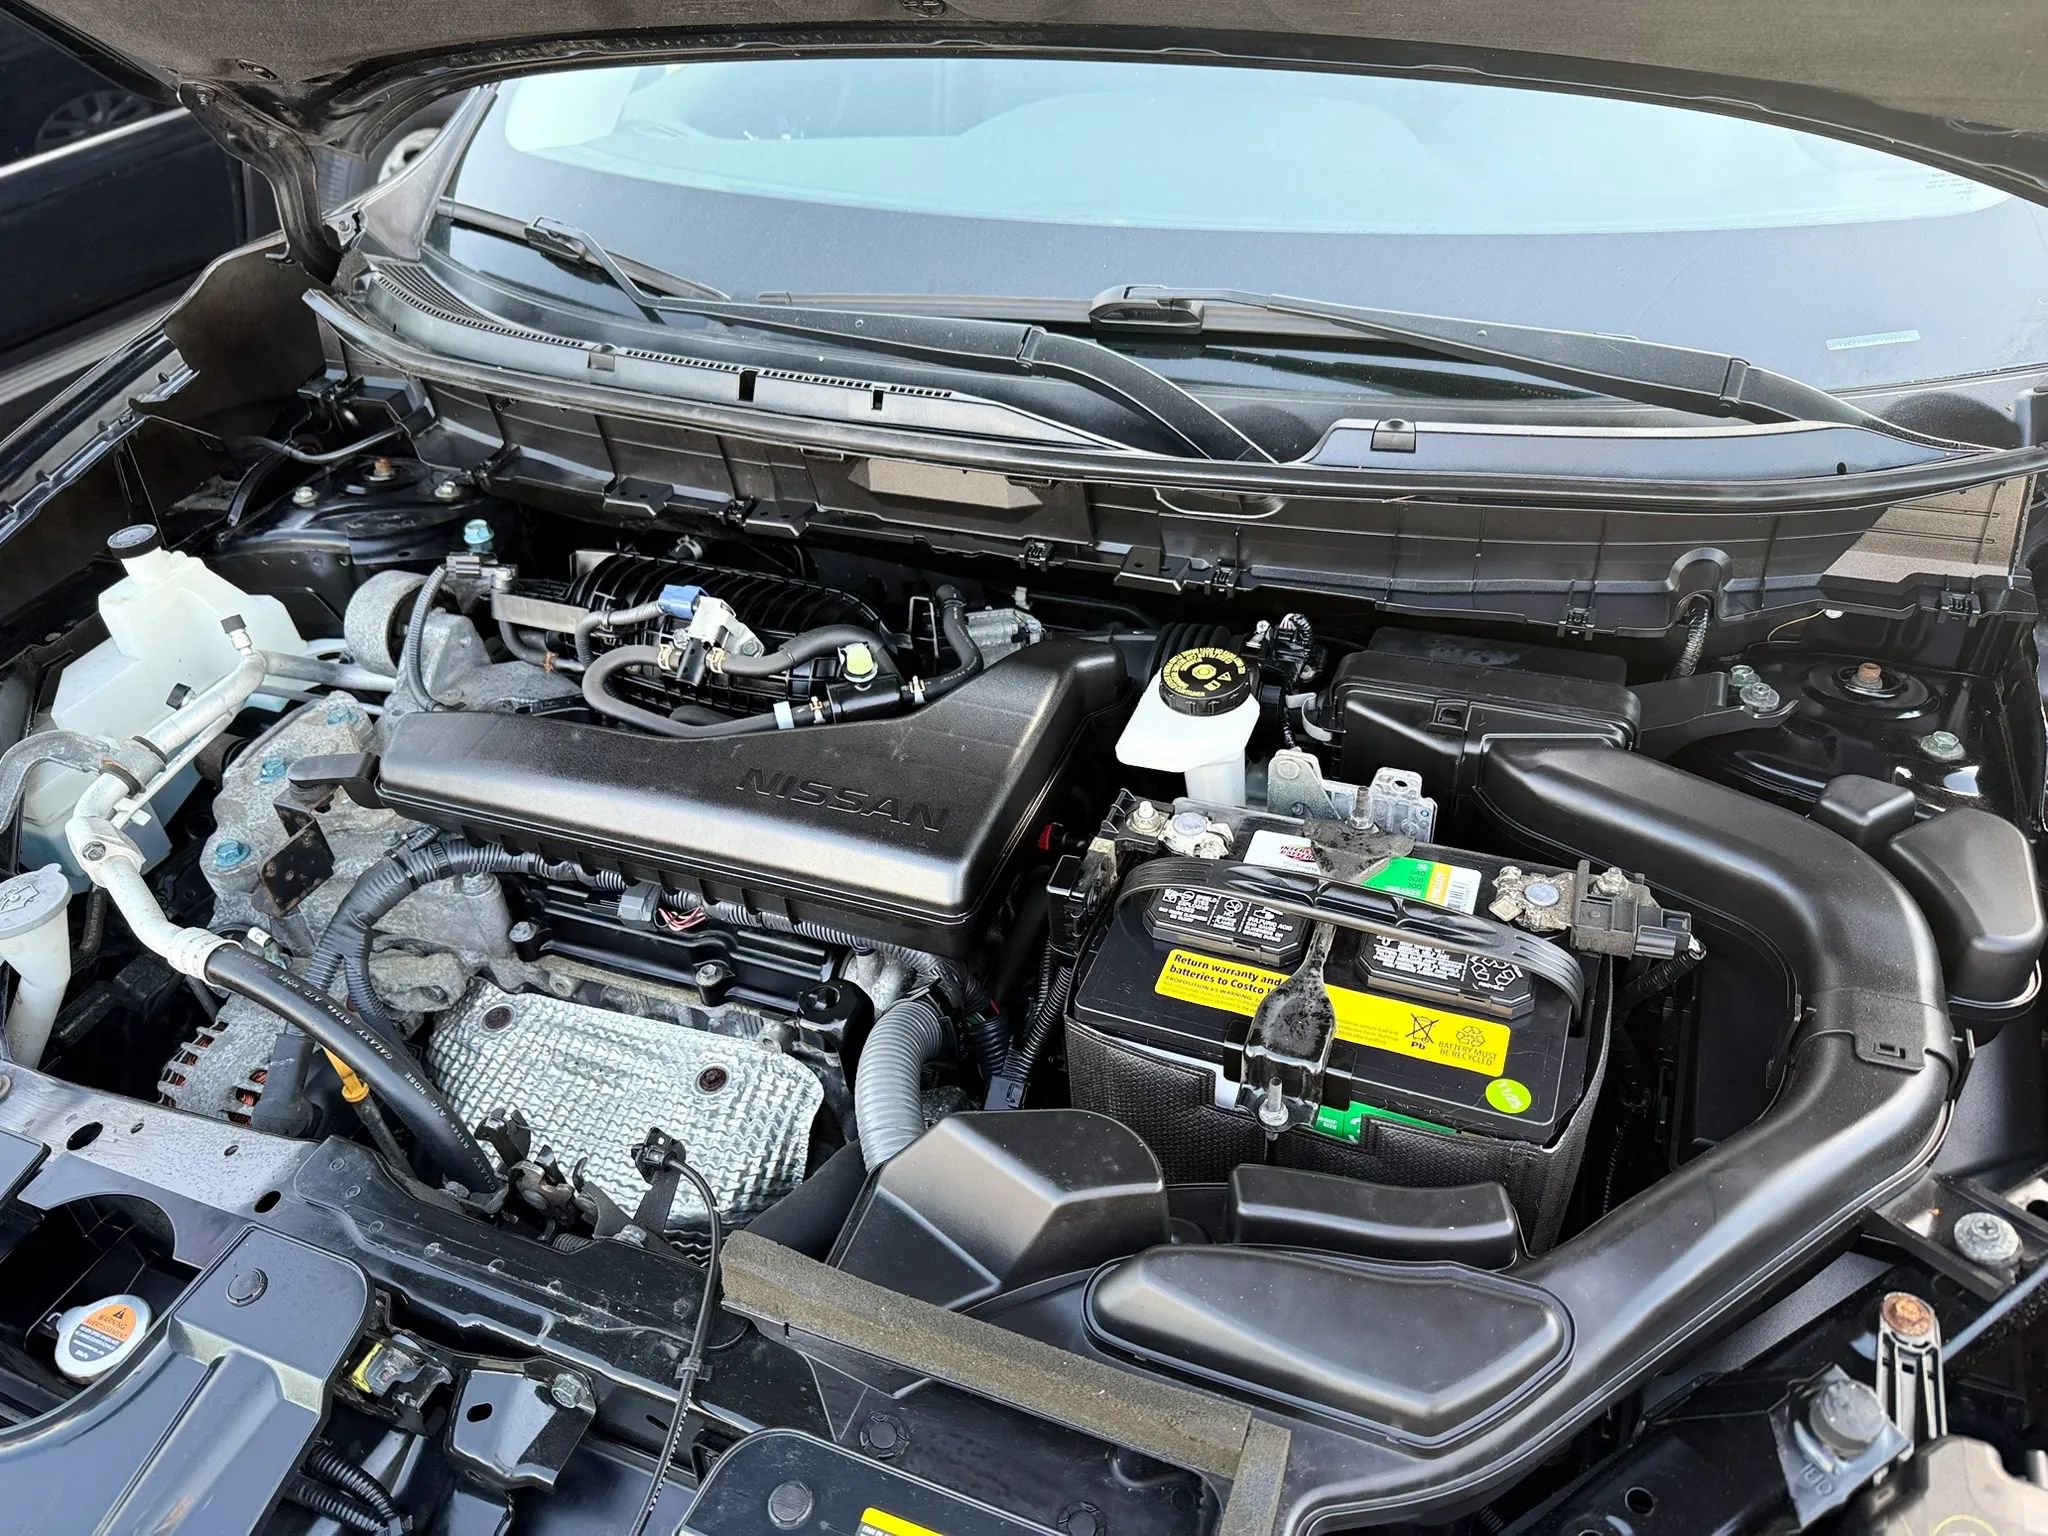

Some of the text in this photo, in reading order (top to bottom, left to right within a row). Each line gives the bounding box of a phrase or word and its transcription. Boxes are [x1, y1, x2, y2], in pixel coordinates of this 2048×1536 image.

[736, 767, 949, 832] NISSAN
[1169, 964, 1264, 994] batteries to Costco
[1174, 954, 1282, 986] Return warranty and
[277, 974, 301, 989] HOSE
[1165, 975, 1209, 991] PROPOSITION
[304, 989, 323, 1003] A/C
[356, 1030, 393, 1060] GALAXY
[1410, 1040, 1426, 1050] Pb
[1438, 1040, 1498, 1060] BATTERY MUST
[1439, 1047, 1493, 1066] BE RECYCLED
[404, 1071, 428, 1096] HOSE
[430, 1099, 447, 1117] A/C
[471, 1156, 497, 1191] GALAXY
[98, 1314, 128, 1330] WARNING
